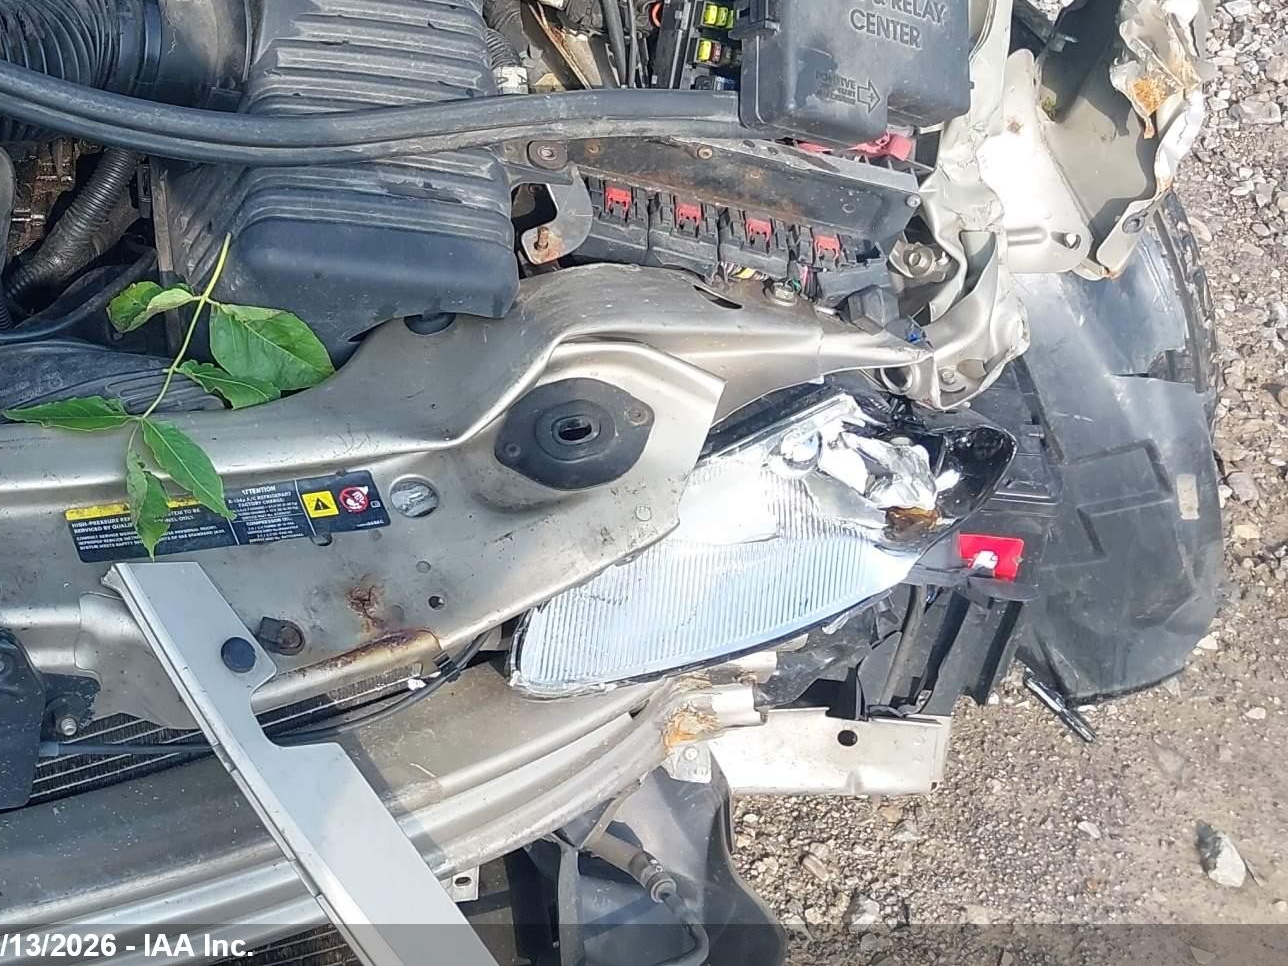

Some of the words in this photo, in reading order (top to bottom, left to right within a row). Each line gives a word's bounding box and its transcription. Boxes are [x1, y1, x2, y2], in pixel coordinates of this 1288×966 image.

[850, 8, 922, 49] CENTER
[241, 485, 276, 495] ATTENTION
[257, 491, 292, 501] REFRIGERANT
[238, 500, 262, 508] FACTORY
[72, 517, 119, 528] HIGH-PRESSURE
[73, 524, 103, 534] SERVICED
